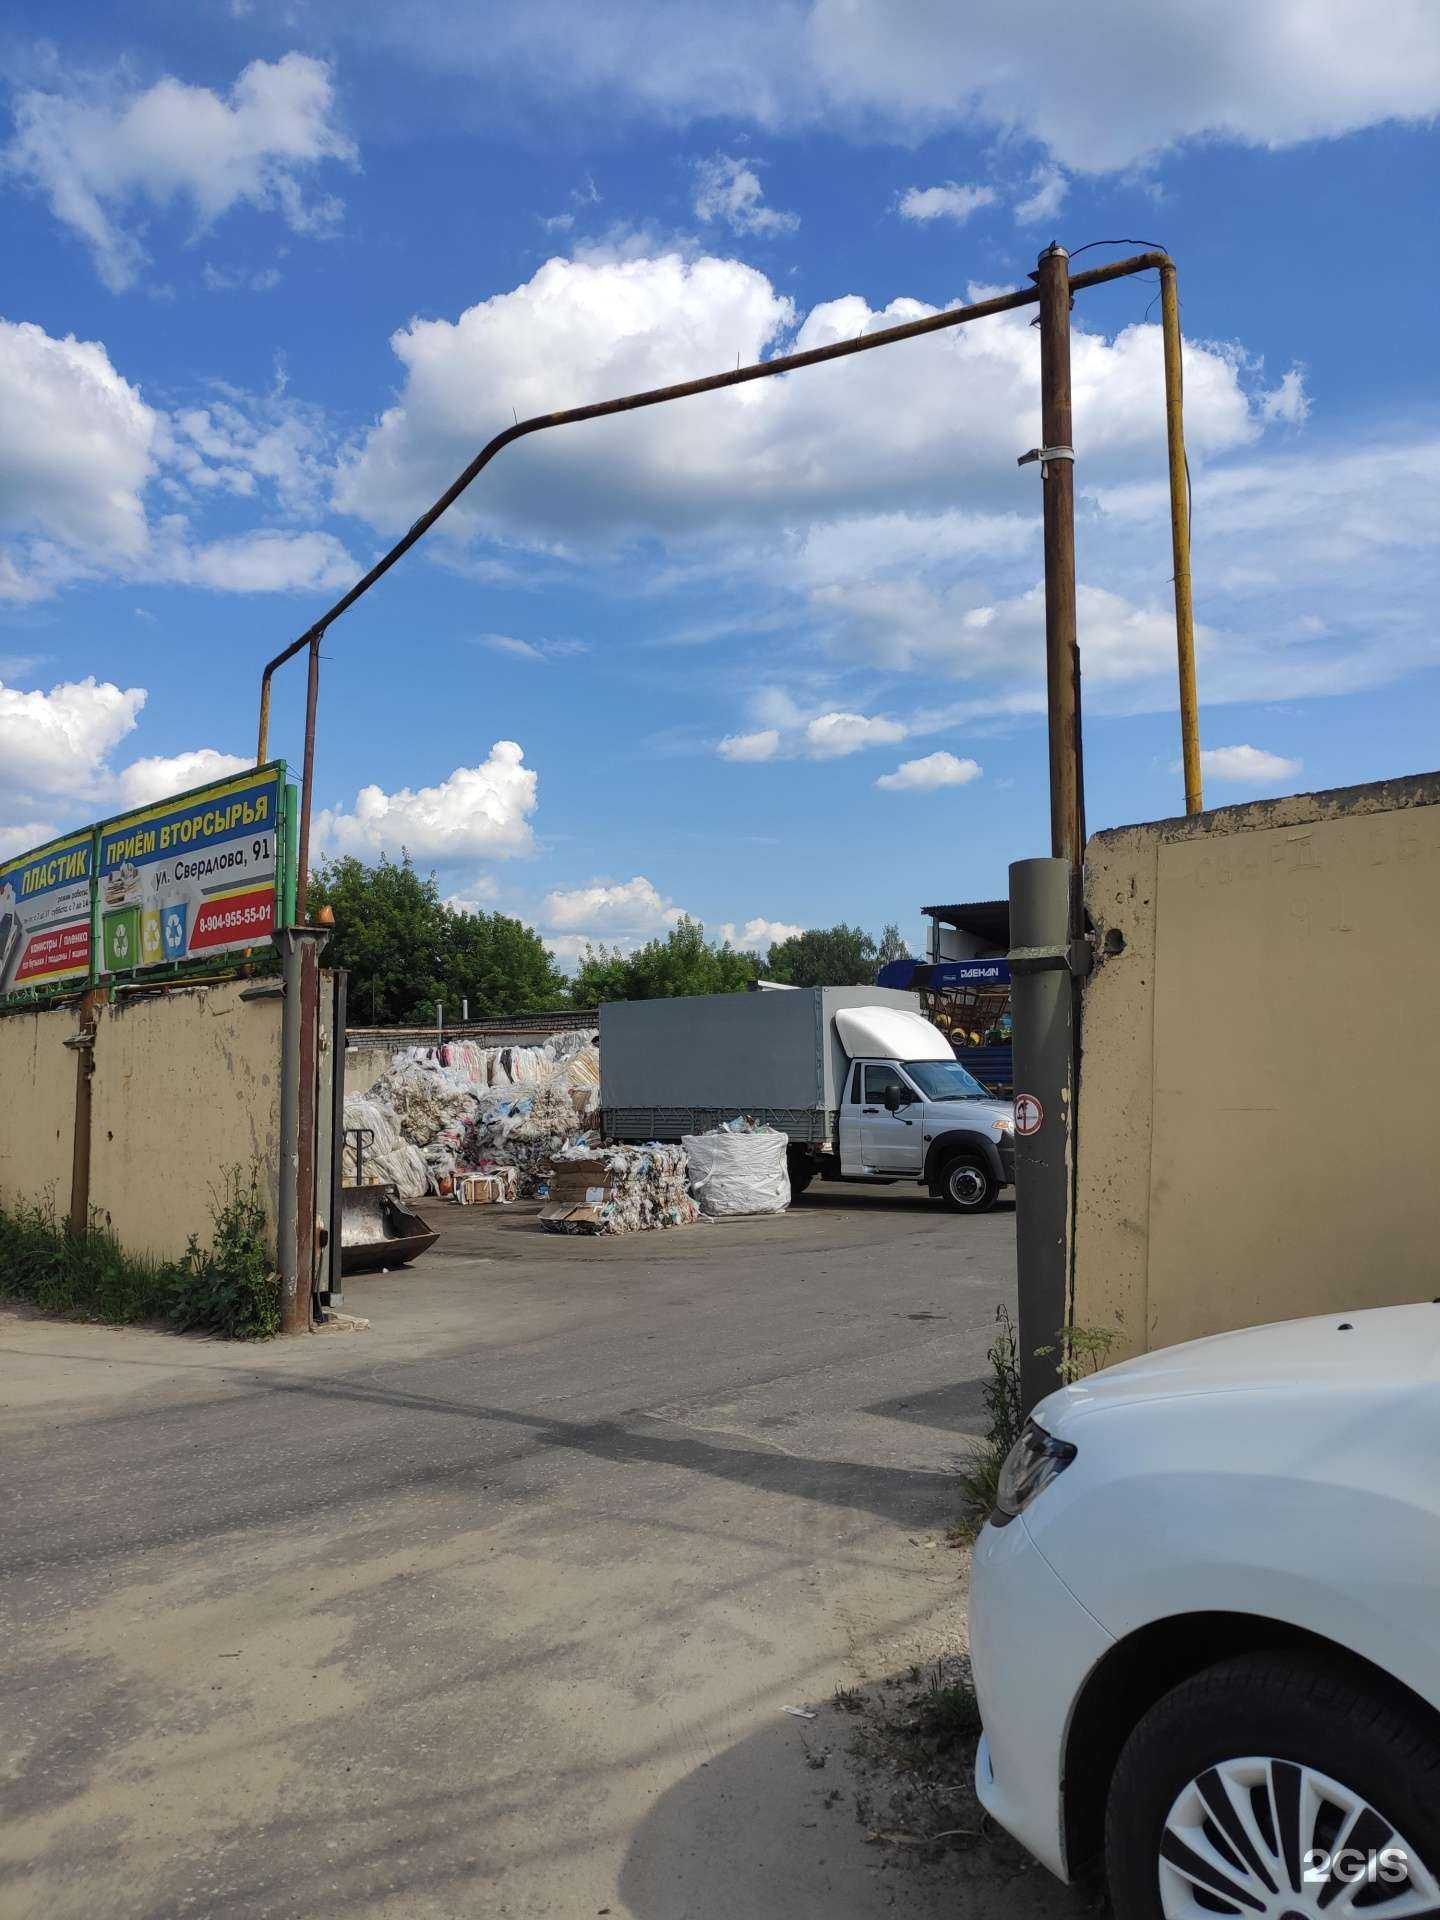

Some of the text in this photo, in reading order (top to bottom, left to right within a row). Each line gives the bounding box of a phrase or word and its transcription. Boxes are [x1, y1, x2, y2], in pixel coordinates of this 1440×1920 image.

[106, 796, 268, 866] ПРИЁМ ВТОРСЫРЬЯ
[21, 849, 88, 896] ПЛАСТИК
[155, 839, 270, 891] ул. Свердлова, 91
[199, 904, 271, 933] 8-904-955-55-01
[960, 967, 999, 979] DAEHAN
